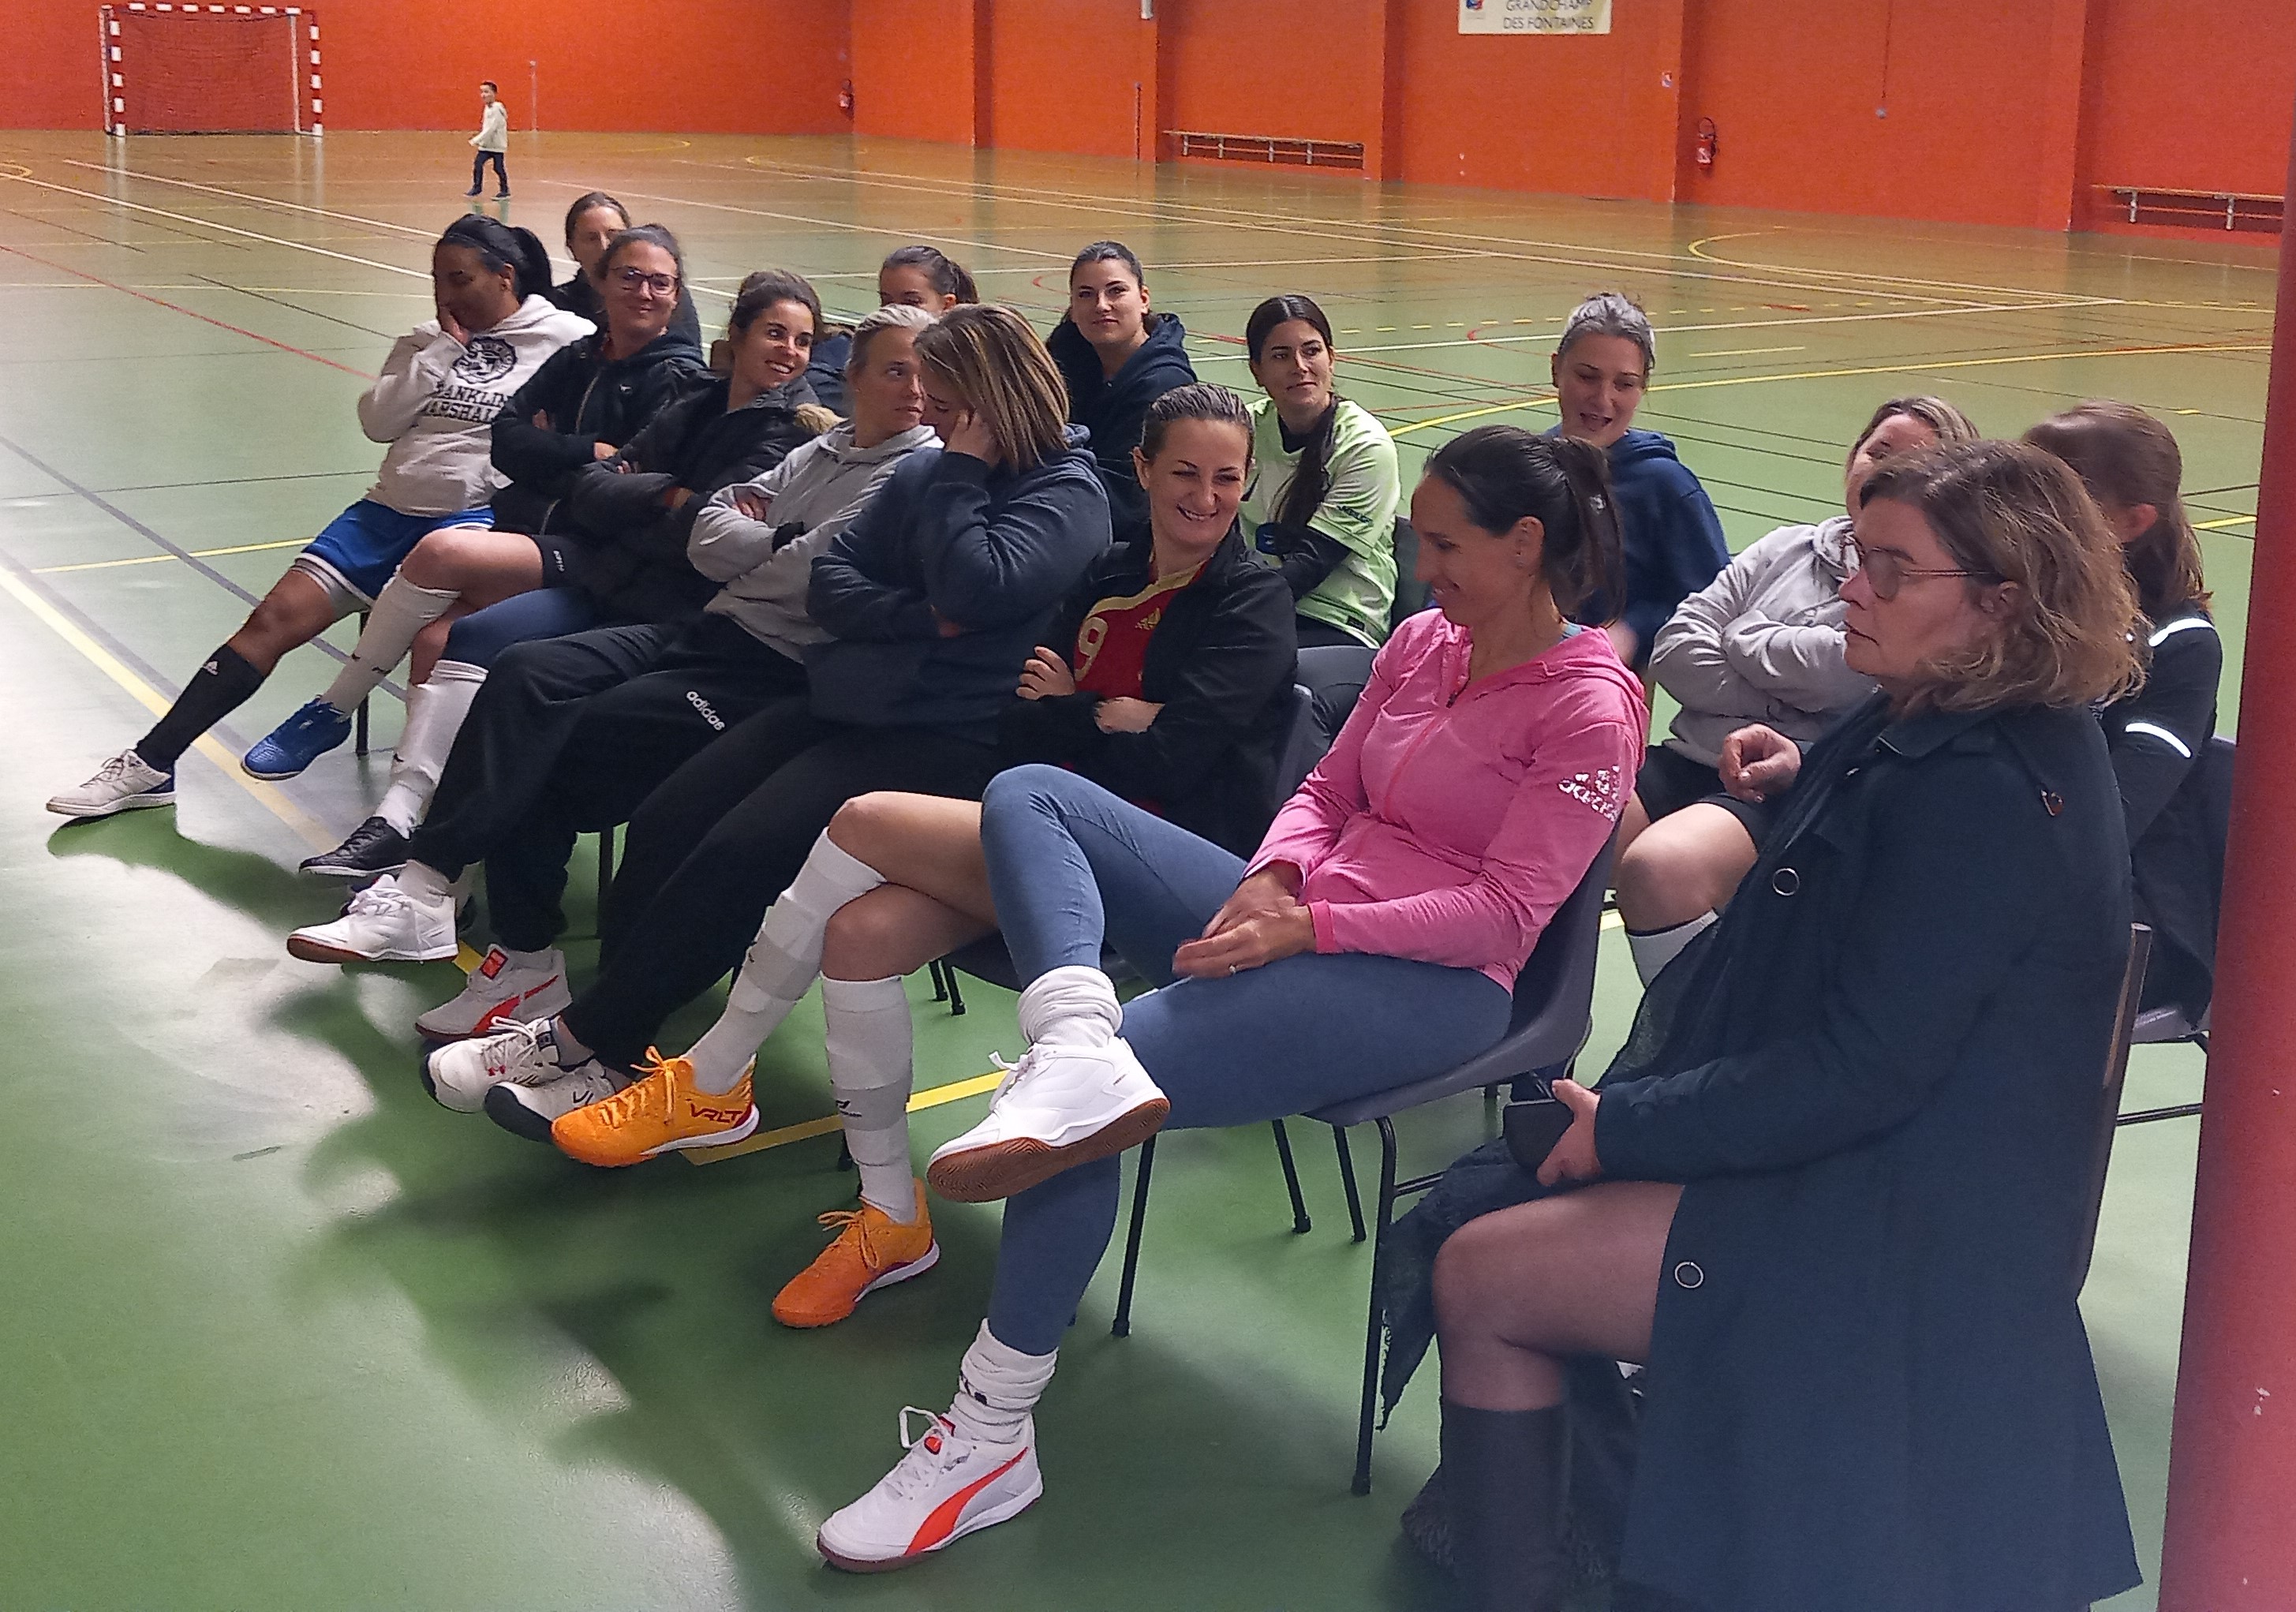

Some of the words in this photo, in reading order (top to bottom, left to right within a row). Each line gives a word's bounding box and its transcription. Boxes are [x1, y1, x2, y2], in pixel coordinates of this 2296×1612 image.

[1504, 17, 1524, 28] DES
[1528, 17, 1594, 28] FONTAINES
[1075, 616, 1109, 682] 9
[686, 691, 725, 731] adidas
